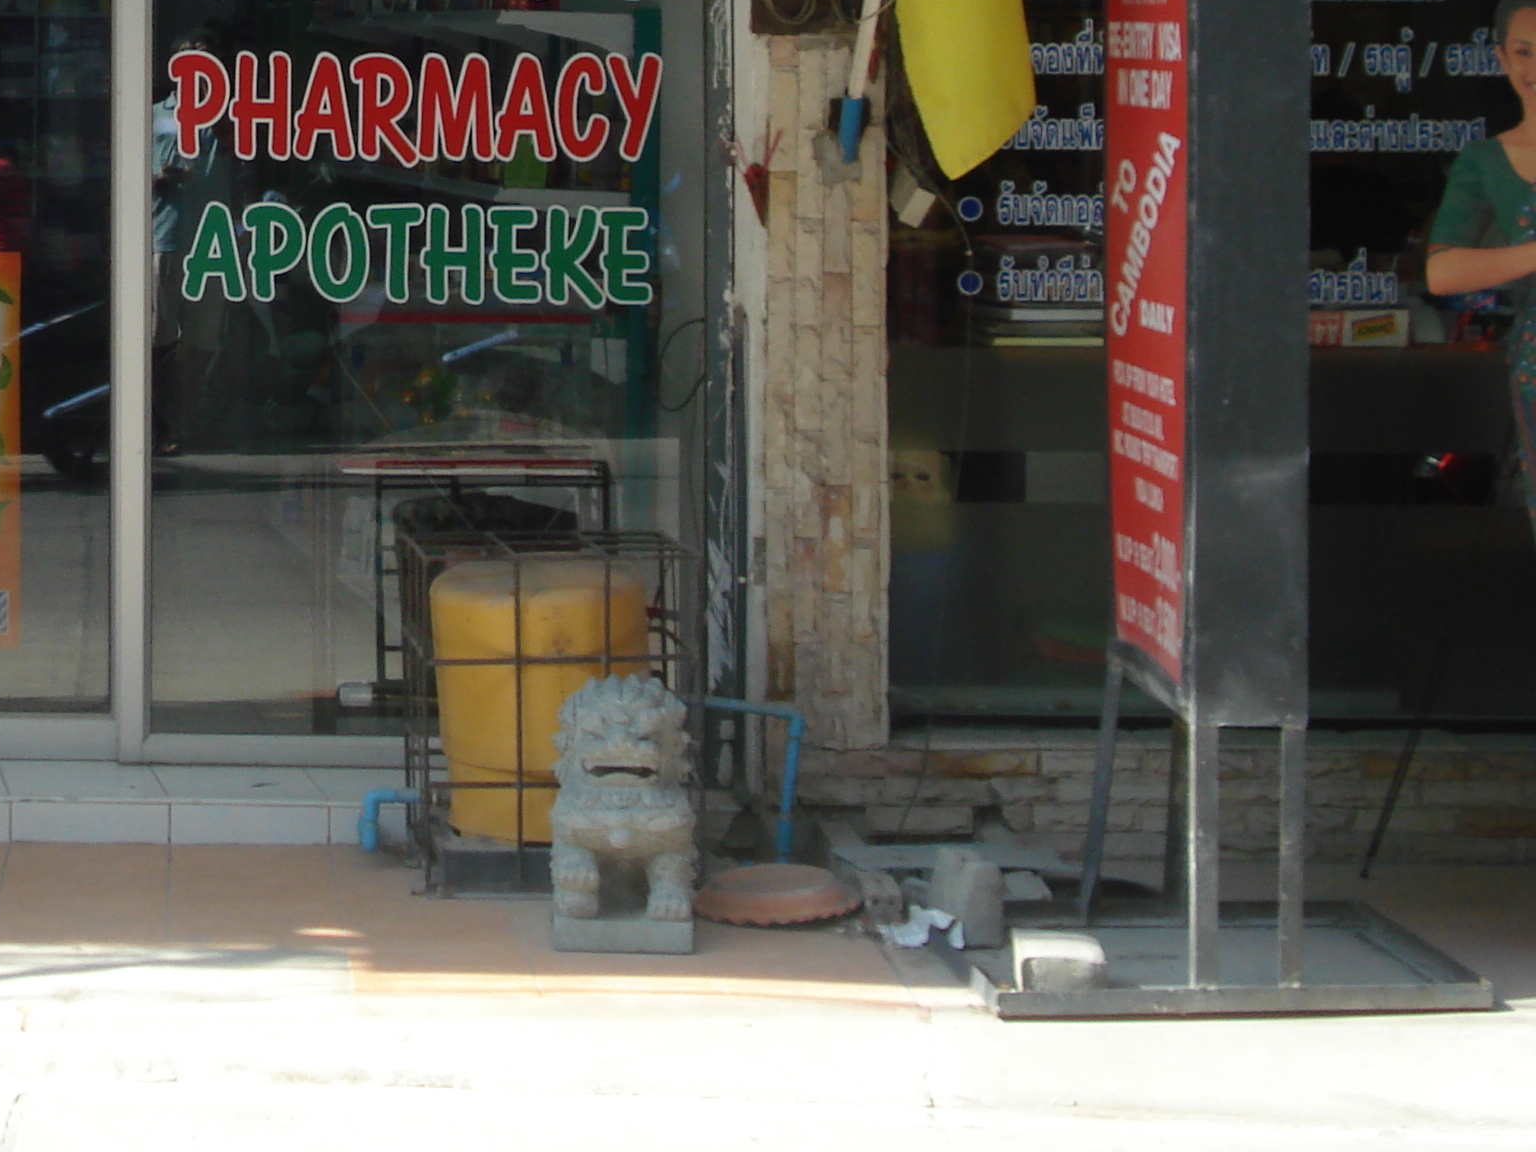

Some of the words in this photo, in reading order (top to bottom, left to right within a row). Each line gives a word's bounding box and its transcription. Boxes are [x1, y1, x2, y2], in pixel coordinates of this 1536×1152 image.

[168, 51, 663, 166] PHARMACY
[1109, 131, 1182, 338] CAMBODIA
[1112, 159, 1138, 215] TO
[182, 201, 654, 308] APOTHEKE
[1138, 297, 1176, 335] DAILY
